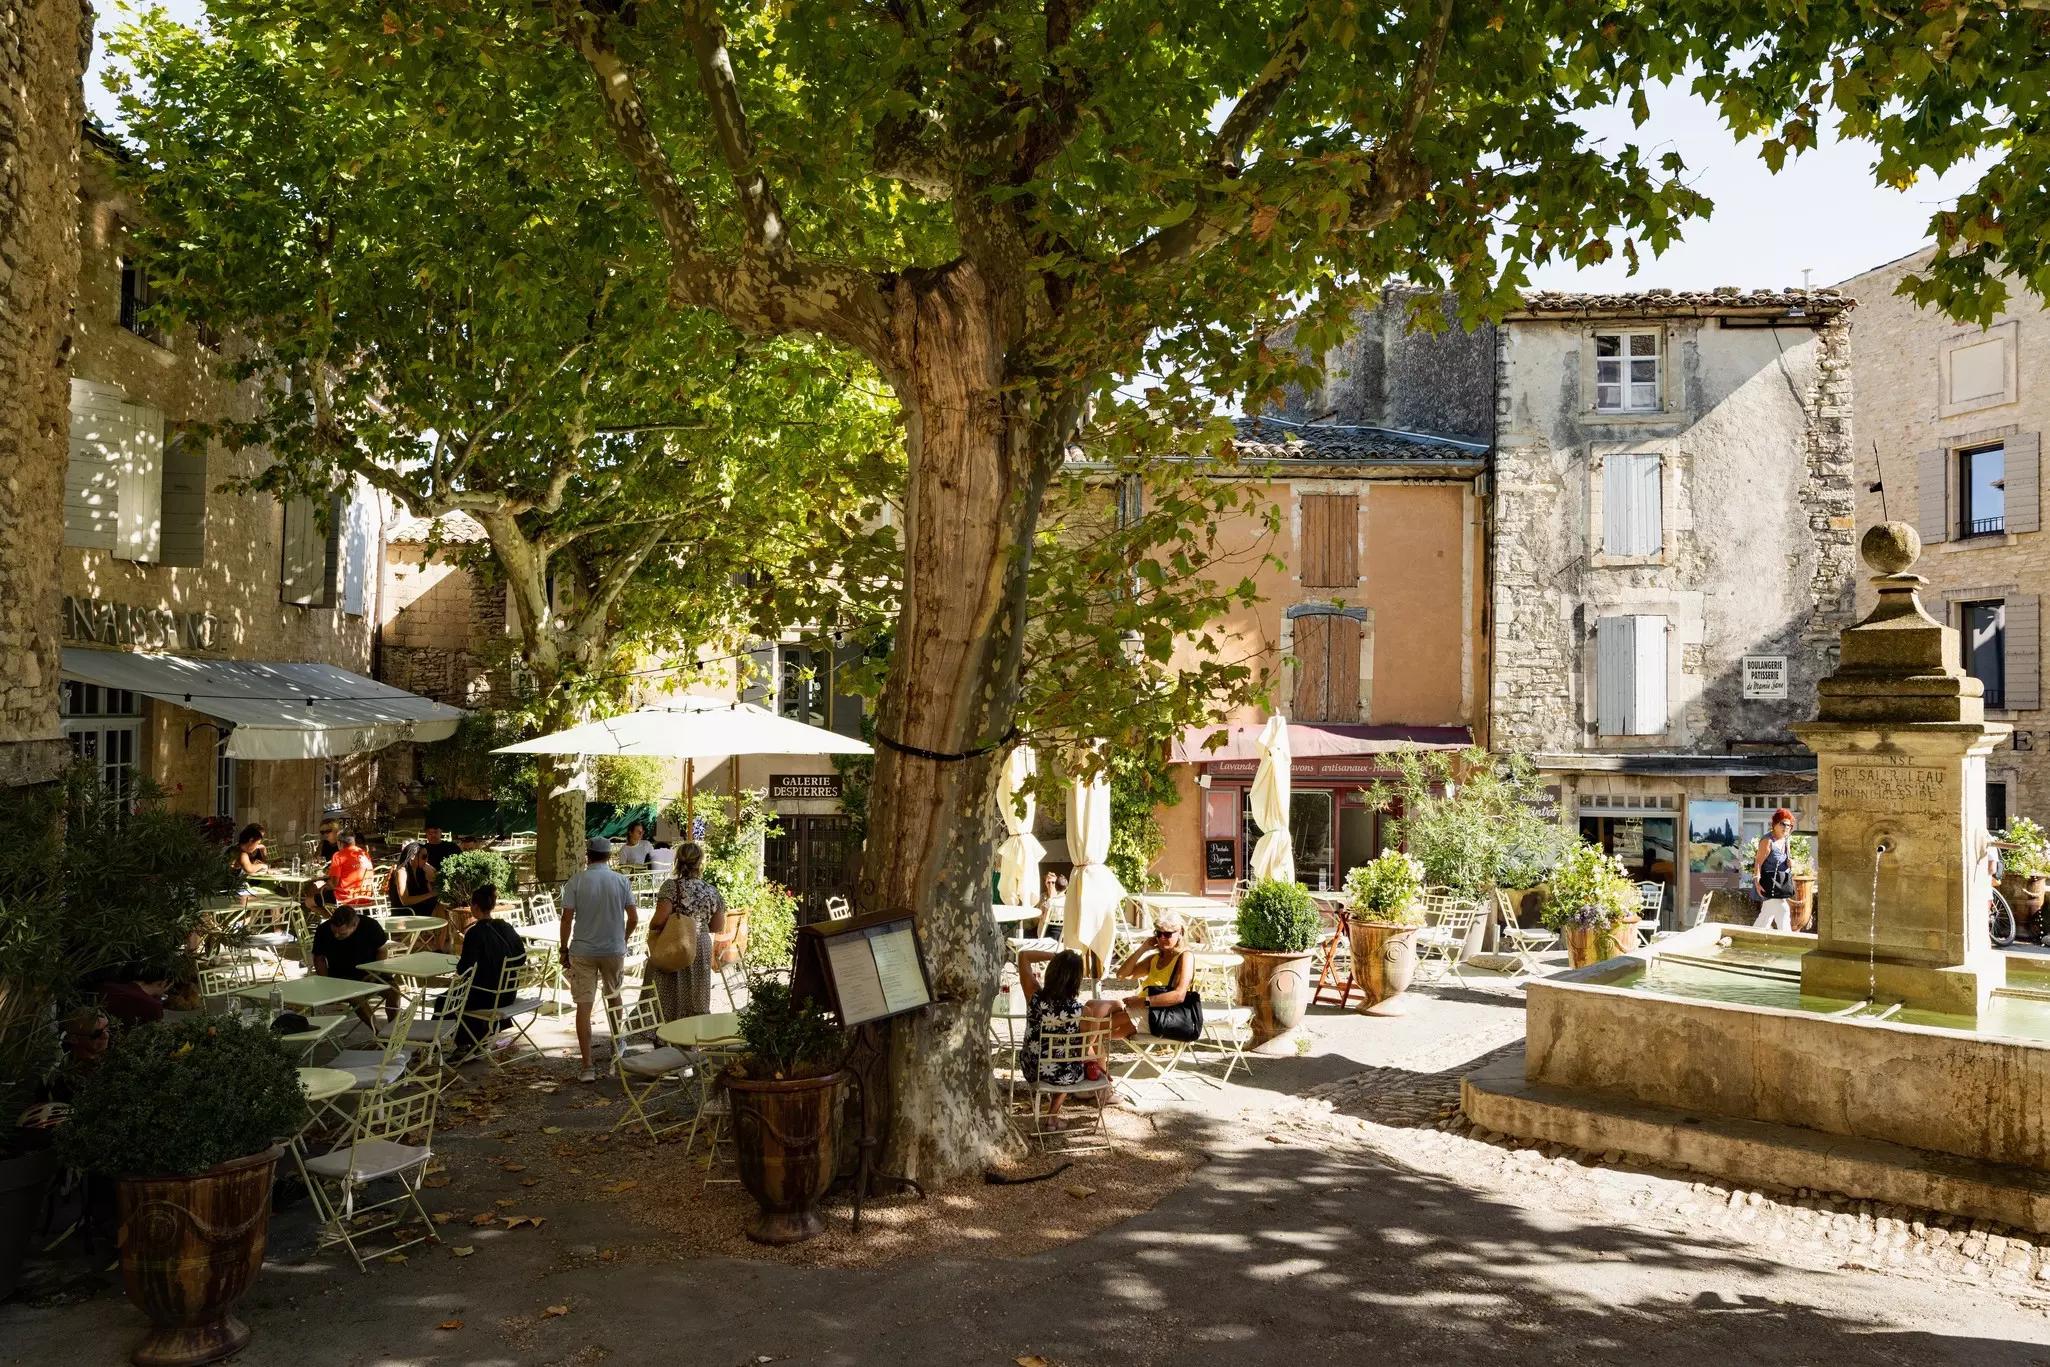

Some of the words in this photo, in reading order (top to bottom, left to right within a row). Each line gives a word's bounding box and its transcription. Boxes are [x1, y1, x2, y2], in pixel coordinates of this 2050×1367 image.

[62, 596, 228, 651] NAISSANCE
[1747, 661, 1782, 670] BOULANGERIE
[1751, 671, 1779, 680] PATISSERIE
[1220, 761, 1256, 770] Lavande
[1290, 763, 1314, 772] avons
[1321, 763, 1368, 773] artisanaux
[782, 777, 831, 786] GALERIE
[774, 786, 838, 797] DESPIERRES
